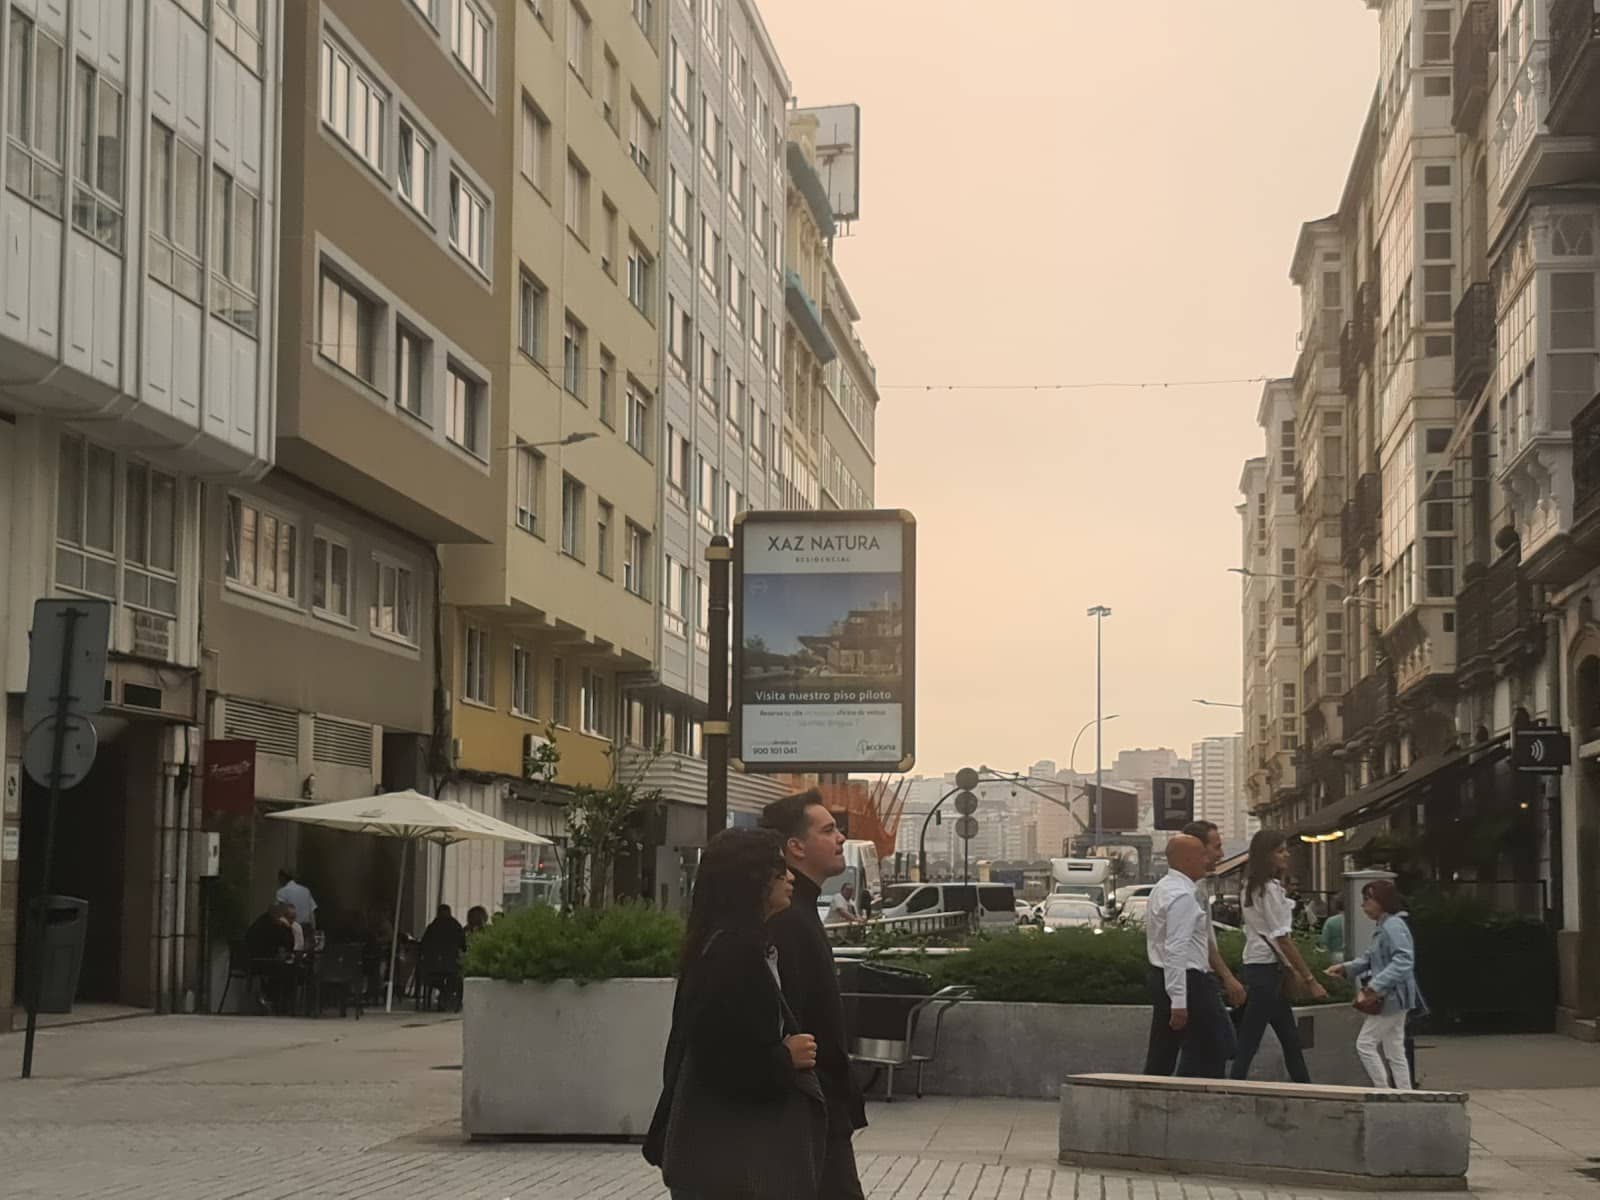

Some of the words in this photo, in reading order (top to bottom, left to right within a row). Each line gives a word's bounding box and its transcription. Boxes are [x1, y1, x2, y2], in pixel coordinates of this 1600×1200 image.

[767, 535, 805, 551] XAZ
[810, 535, 881, 551] NATURA
[755, 690, 786, 701] Visita
[788, 690, 831, 701] nuestro
[833, 690, 857, 702] piso
[859, 689, 892, 702] piloto
[866, 743, 896, 751] acciona
[1164, 782, 1187, 809] P
